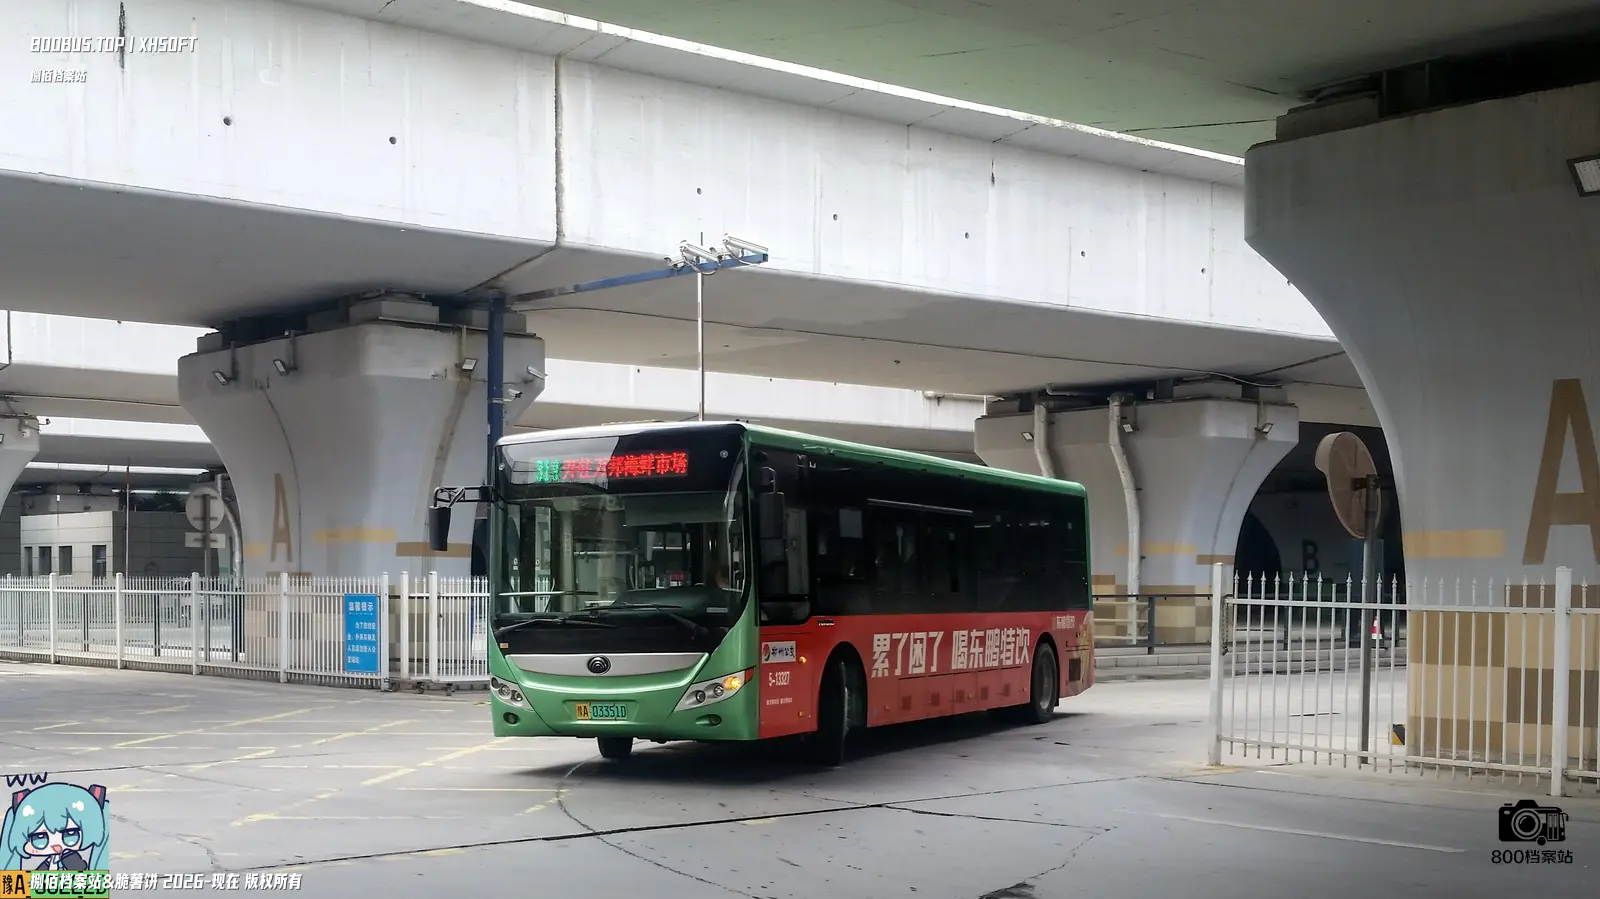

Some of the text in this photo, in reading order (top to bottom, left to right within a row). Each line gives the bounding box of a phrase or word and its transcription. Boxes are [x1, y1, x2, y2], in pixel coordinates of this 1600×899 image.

[270, 473, 293, 562] A
[1302, 540, 1320, 574] B
[348, 601, 374, 612] 温馨提示
[871, 626, 1031, 678] 累了困了 喝东鹏特饮
